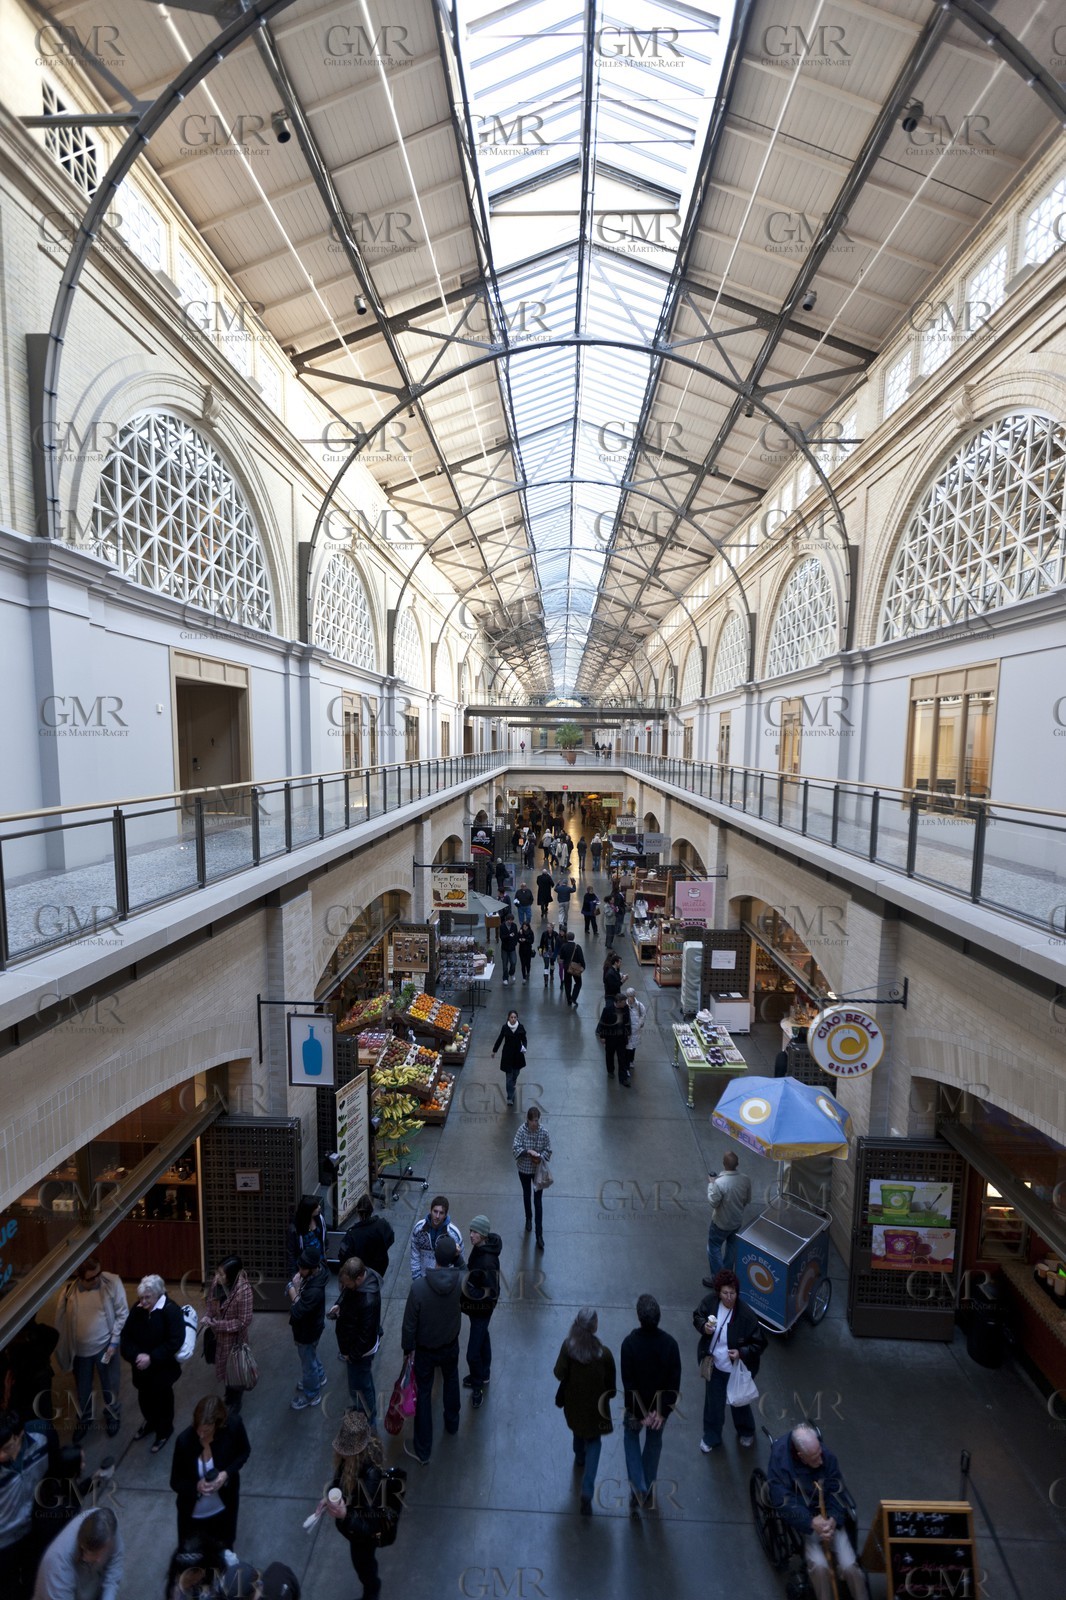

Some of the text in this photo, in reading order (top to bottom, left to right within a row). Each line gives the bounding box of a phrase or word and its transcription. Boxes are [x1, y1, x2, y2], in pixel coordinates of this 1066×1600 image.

[817, 1015, 841, 1039] CIAO
[844, 1013, 879, 1039] BELLA
[828, 1062, 868, 1074] GELATO
[738, 1131, 767, 1156] BELLA
[741, 1253, 780, 1283] CIAO BELLA
